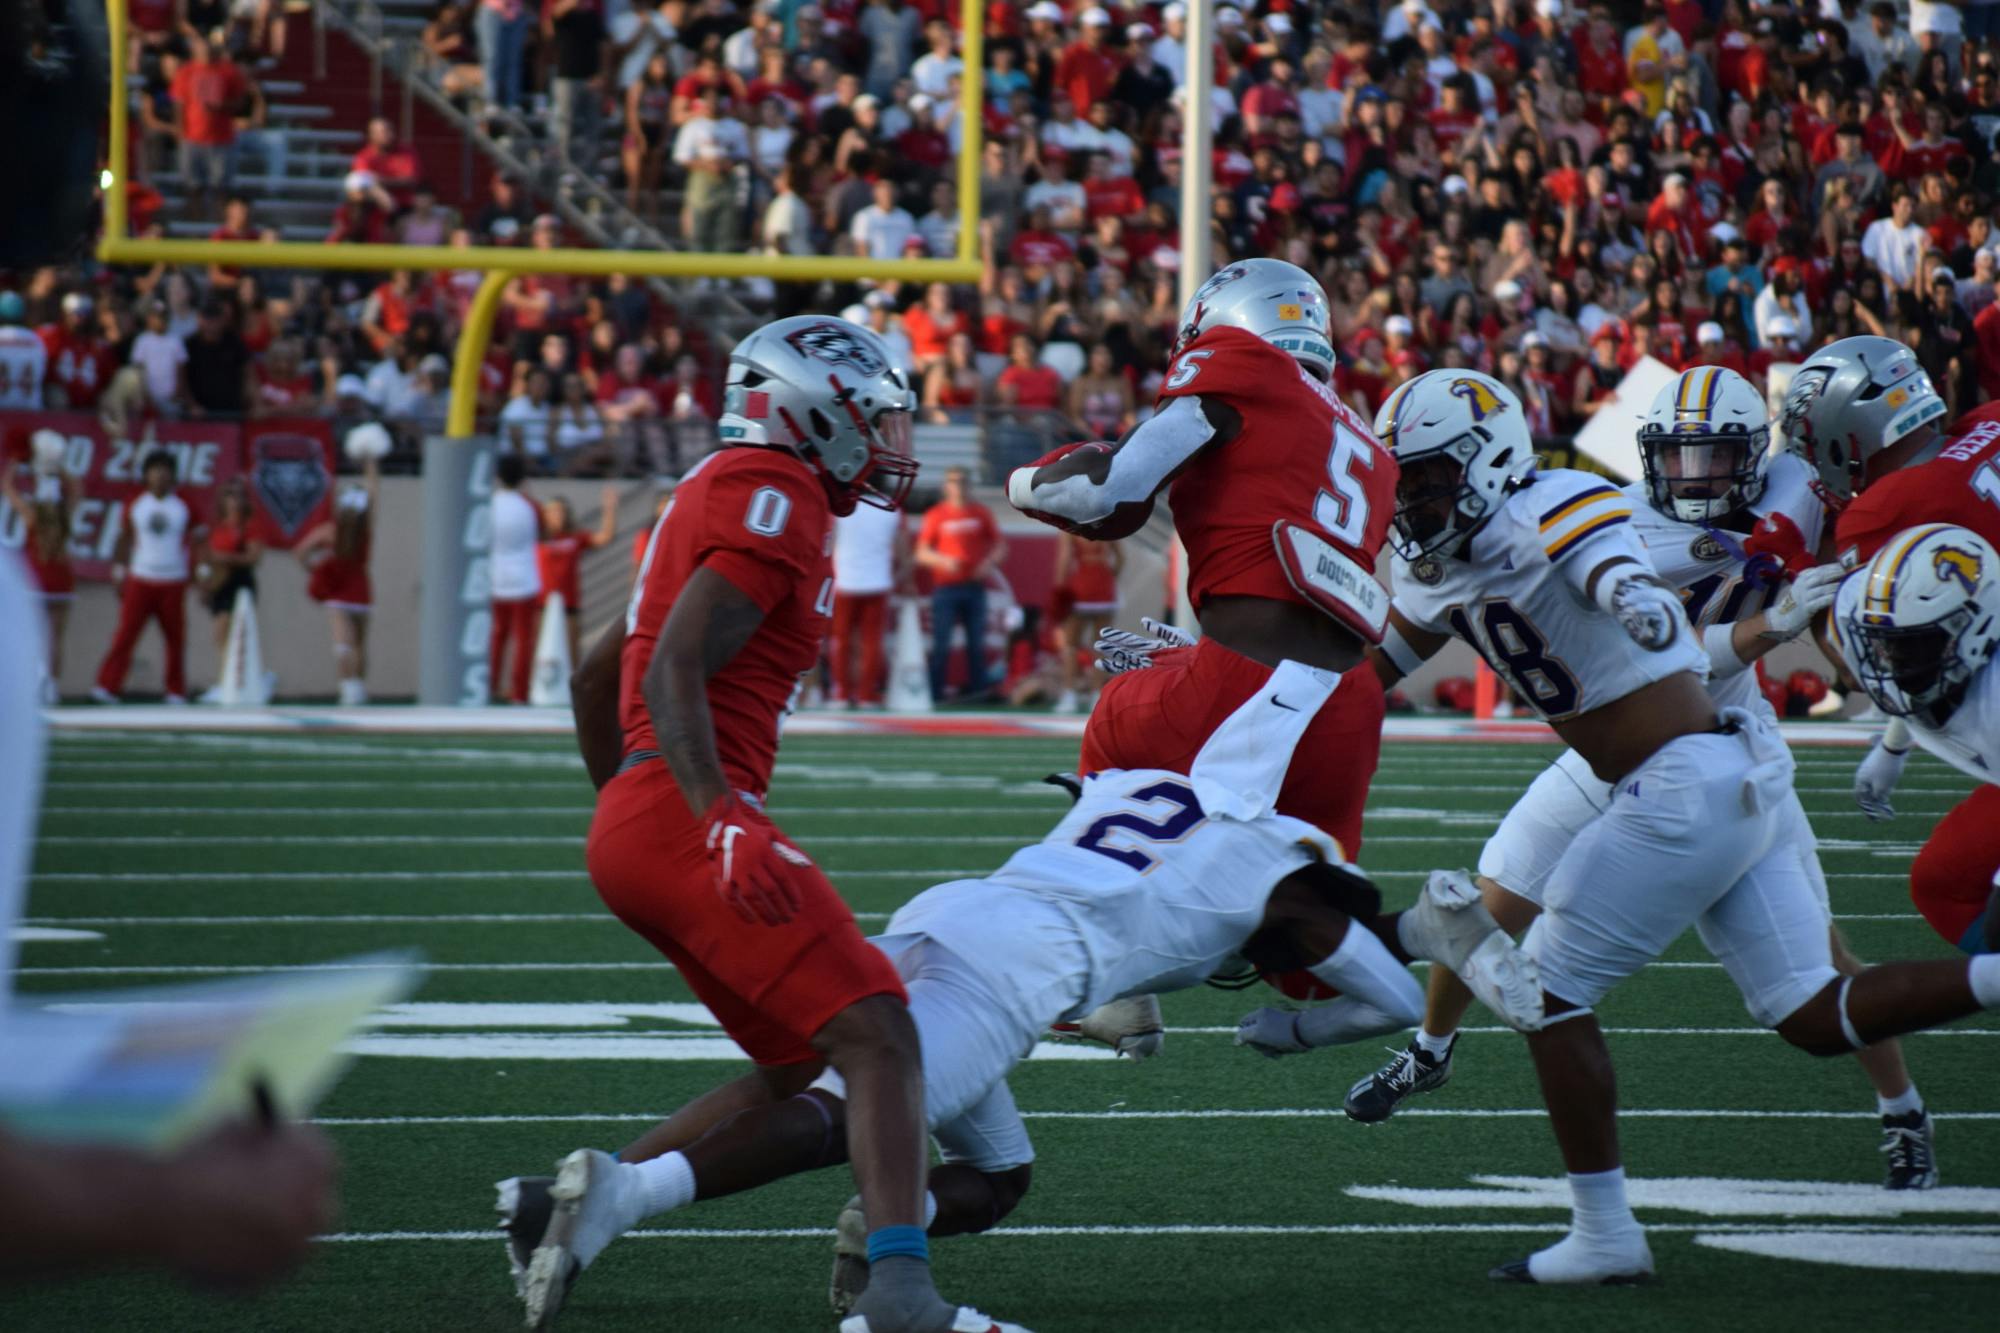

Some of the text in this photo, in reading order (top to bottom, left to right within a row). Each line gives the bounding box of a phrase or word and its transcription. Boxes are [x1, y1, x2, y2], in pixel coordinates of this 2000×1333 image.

[1166, 350, 1214, 391] 5
[743, 485, 792, 537] 0
[1313, 418, 1375, 548] 5
[1447, 597, 1584, 723] 18
[1074, 777, 1208, 876] 2
